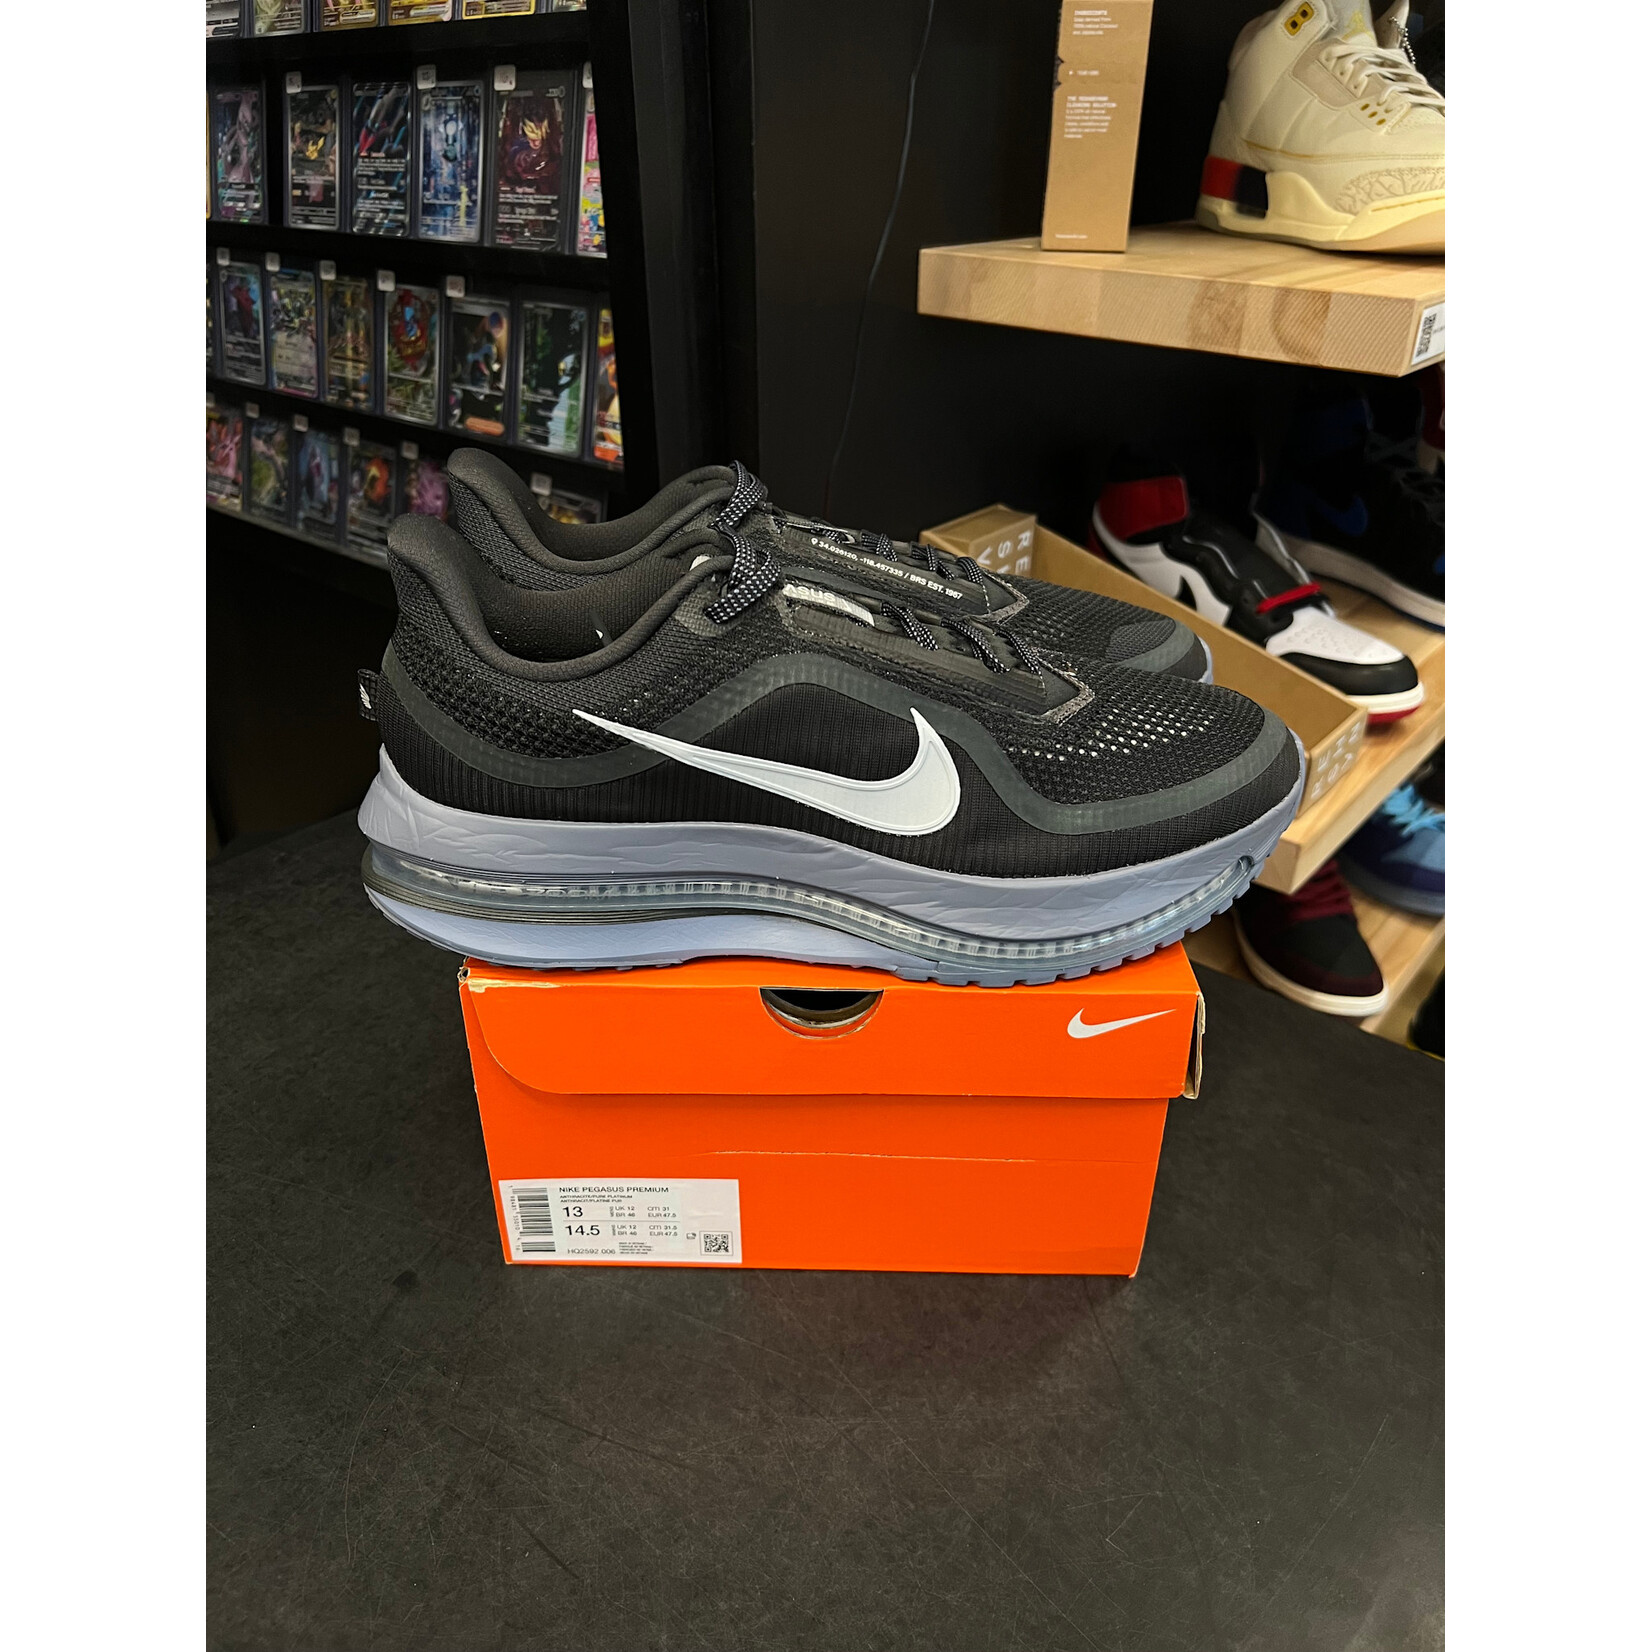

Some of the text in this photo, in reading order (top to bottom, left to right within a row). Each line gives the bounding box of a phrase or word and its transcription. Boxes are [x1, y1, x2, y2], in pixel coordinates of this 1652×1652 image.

[909, 574, 927, 586] BRS
[562, 1206, 584, 1218] 13
[564, 1224, 601, 1236] 14.5
